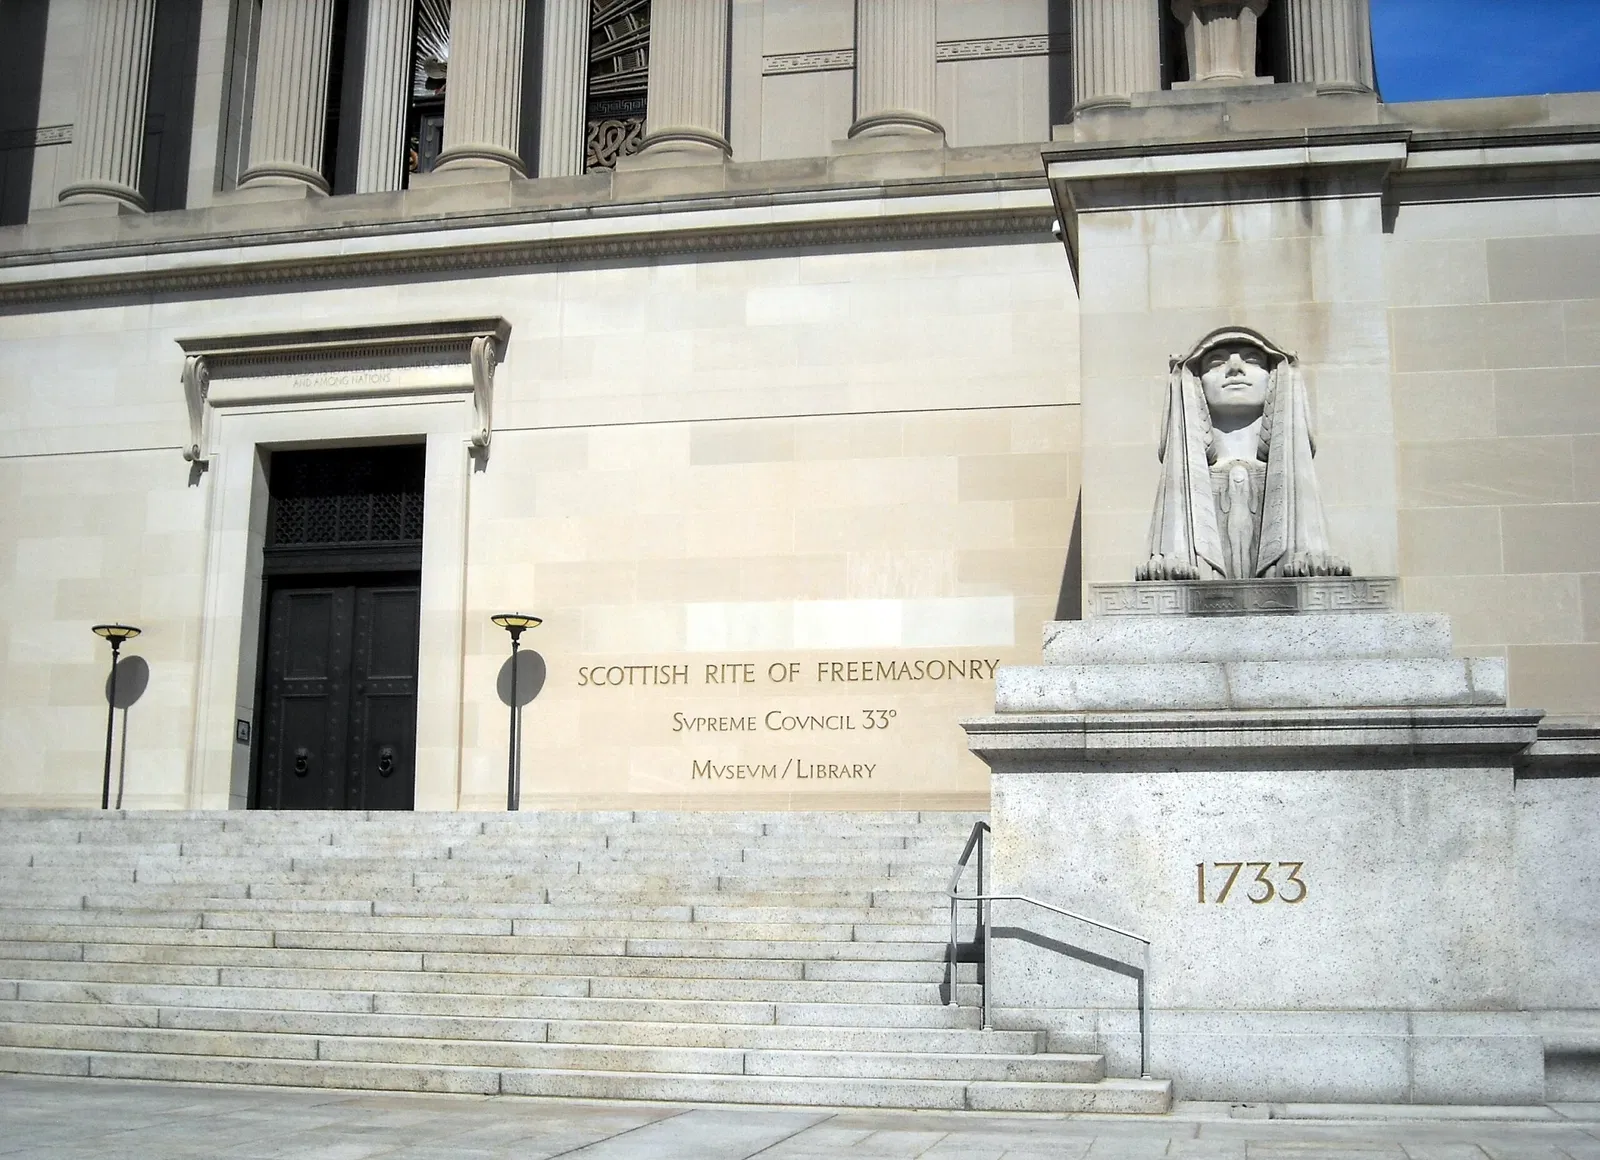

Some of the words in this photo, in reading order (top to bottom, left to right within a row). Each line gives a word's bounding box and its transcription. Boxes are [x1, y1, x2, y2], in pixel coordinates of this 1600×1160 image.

[293, 379, 312, 388] AND
[314, 376, 349, 387] AMONG
[351, 372, 391, 385] NATIONS
[577, 664, 689, 686] SCOTTISH
[705, 663, 756, 684] RITE
[768, 662, 801, 683] OF
[817, 658, 1000, 682] FREEMASONRY
[1195, 862, 1307, 904] 1733
